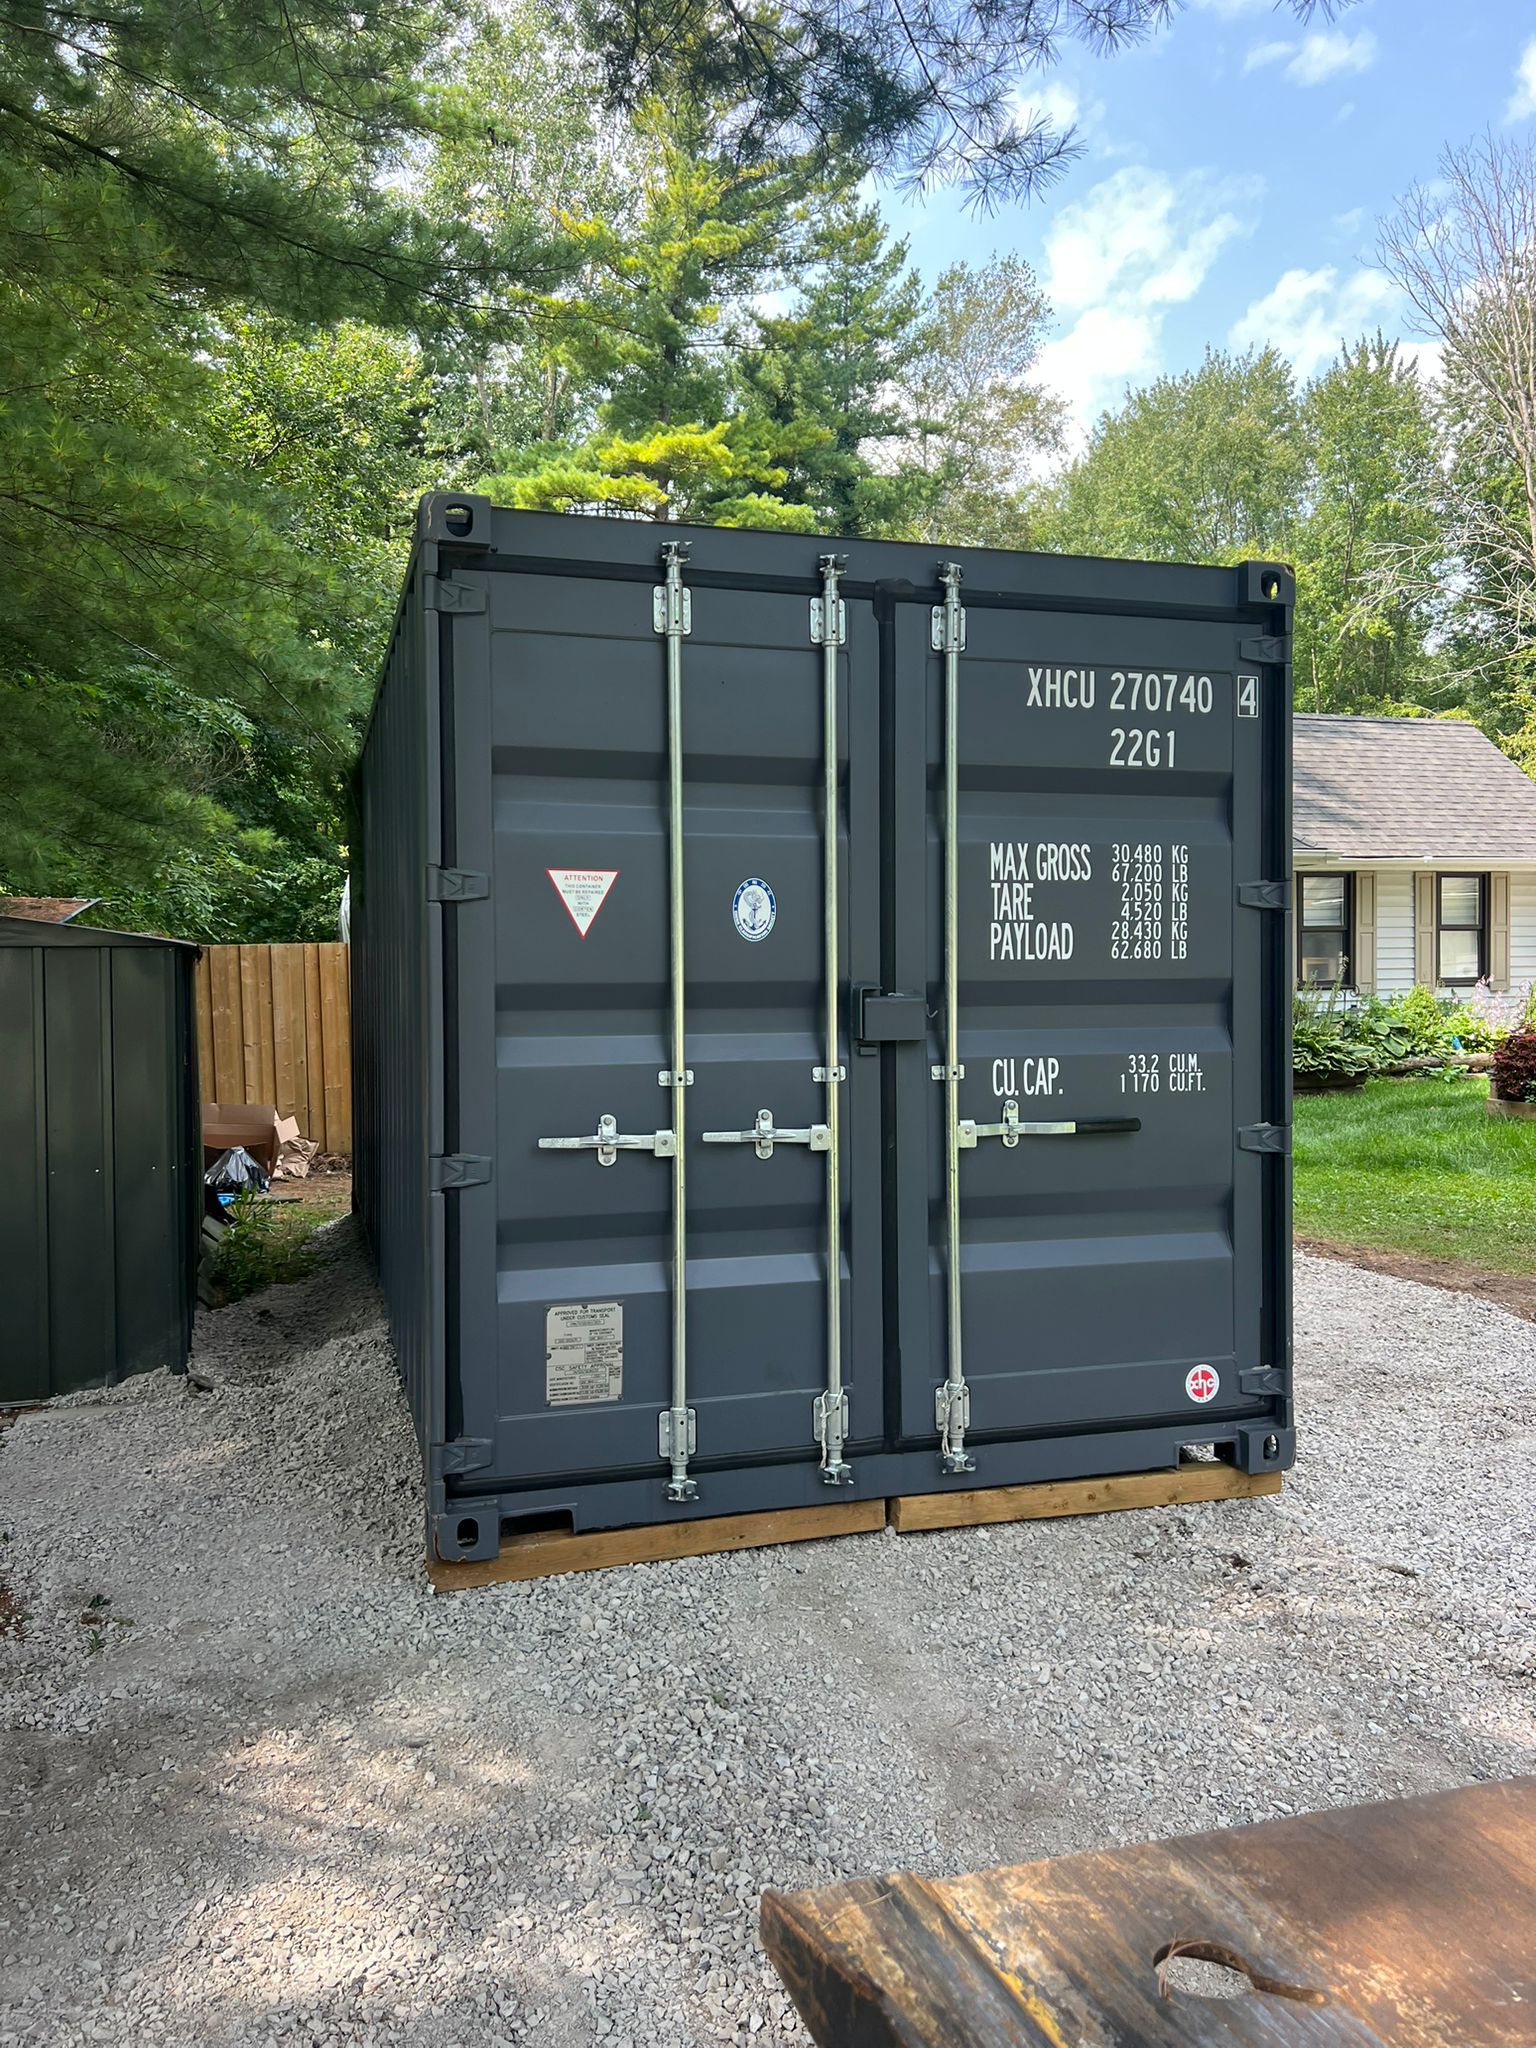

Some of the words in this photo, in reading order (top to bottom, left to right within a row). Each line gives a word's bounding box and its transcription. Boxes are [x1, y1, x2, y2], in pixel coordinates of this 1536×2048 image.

[1026, 667, 1095, 709] XHCU
[1109, 671, 1213, 714] 270740
[1240, 678, 1256, 715] 4
[1109, 727, 1175, 767] 22G1
[990, 842, 1030, 881] MAX
[1035, 843, 1092, 881] GROSS
[1111, 843, 1163, 864] 30,480
[1171, 844, 1189, 864] KG
[1111, 862, 1163, 883] 67,200
[1171, 863, 1188, 883] LB
[990, 882, 1035, 921] TARE
[1121, 882, 1163, 902] 2,050
[1171, 883, 1189, 902] KG
[1120, 901, 1162, 921] 4,520
[1171, 902, 1188, 922] LB
[1111, 920, 1162, 941] 28,430
[1171, 922, 1188, 941] KG
[990, 922, 1074, 961] PAYLOAD
[1110, 940, 1162, 960] 62,680
[1170, 940, 1188, 960] LB
[1128, 1054, 1160, 1074] 33.2
[1169, 1053, 1202, 1073] CU.M.
[1169, 1072, 1206, 1092] CU.FT.
